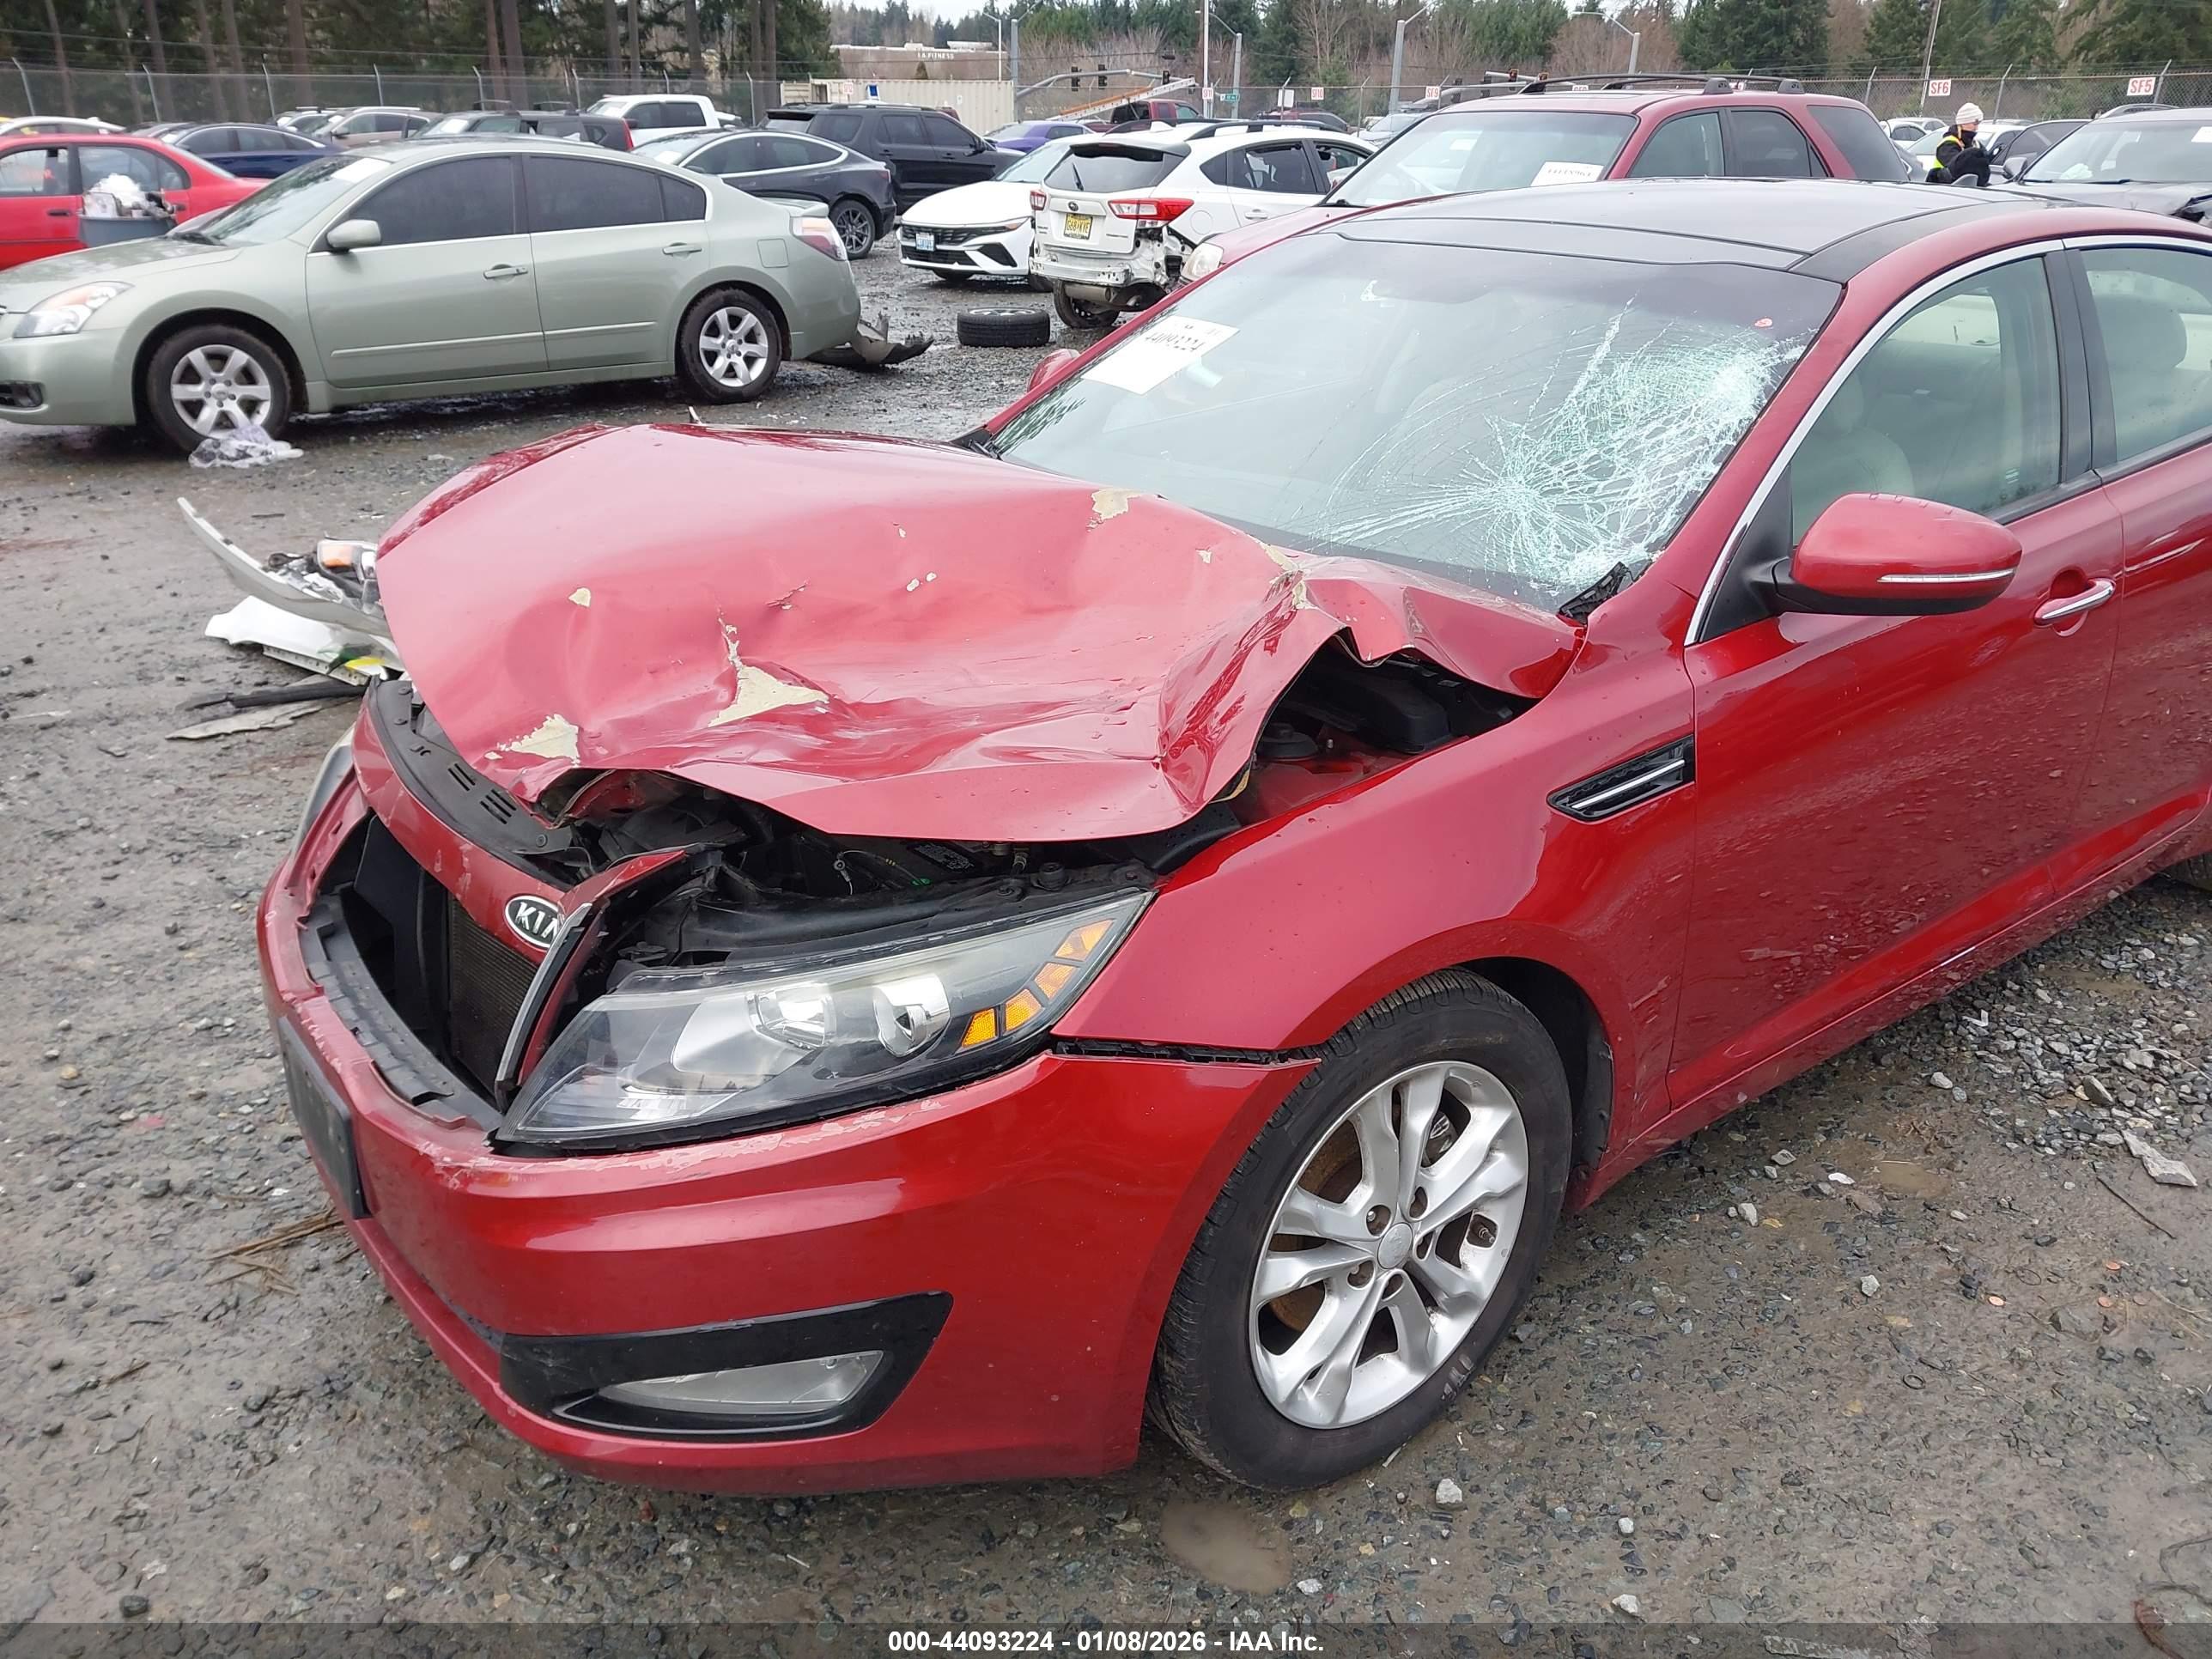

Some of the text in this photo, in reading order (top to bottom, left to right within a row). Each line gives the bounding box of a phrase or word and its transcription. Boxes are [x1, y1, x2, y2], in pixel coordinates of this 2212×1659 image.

[1427, 88, 1439, 98] SF9
[1930, 82, 1949, 94] SF6
[2130, 79, 2153, 94] SF5
[516, 901, 560, 939] KIA
